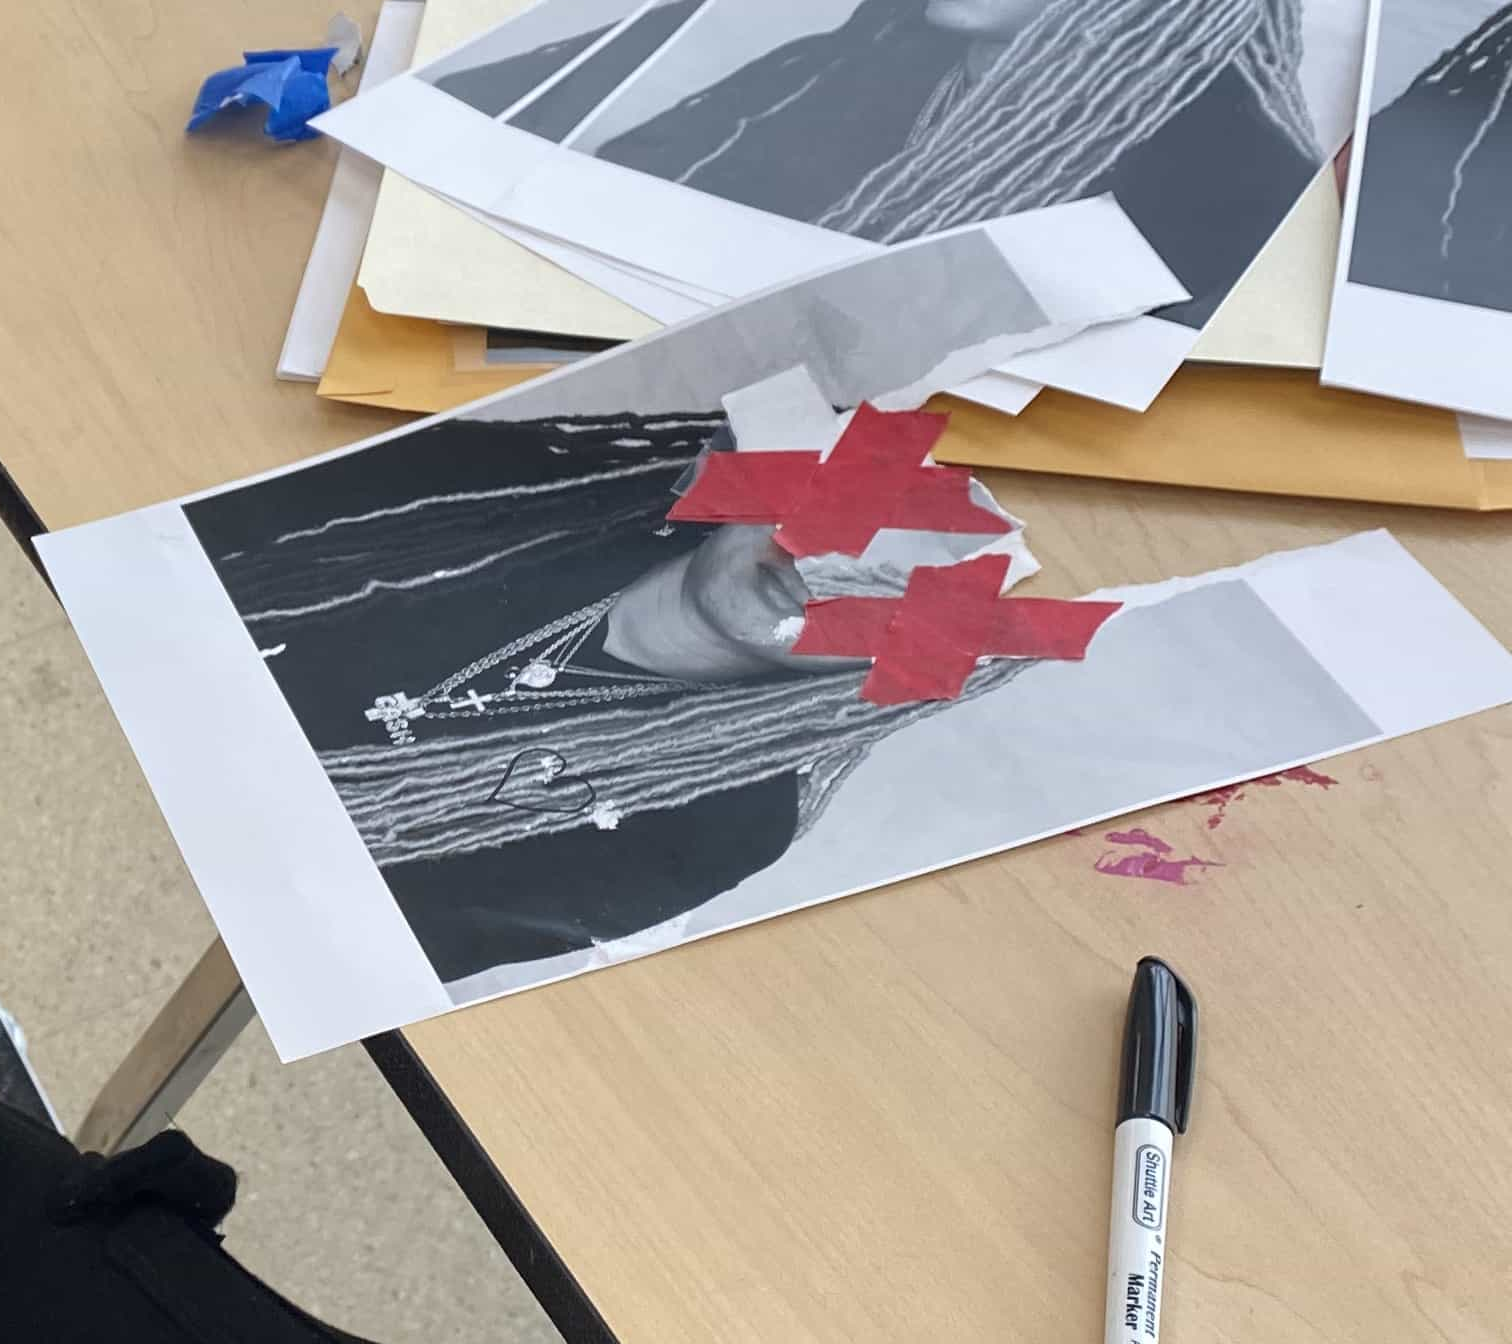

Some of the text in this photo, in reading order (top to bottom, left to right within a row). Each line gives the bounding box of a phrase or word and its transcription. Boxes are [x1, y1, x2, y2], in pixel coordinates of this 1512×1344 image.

[1142, 1151, 1161, 1223] Shuttle Art
[1125, 1273, 1144, 1330] Marker
[1145, 1250, 1162, 1338] Permanent
